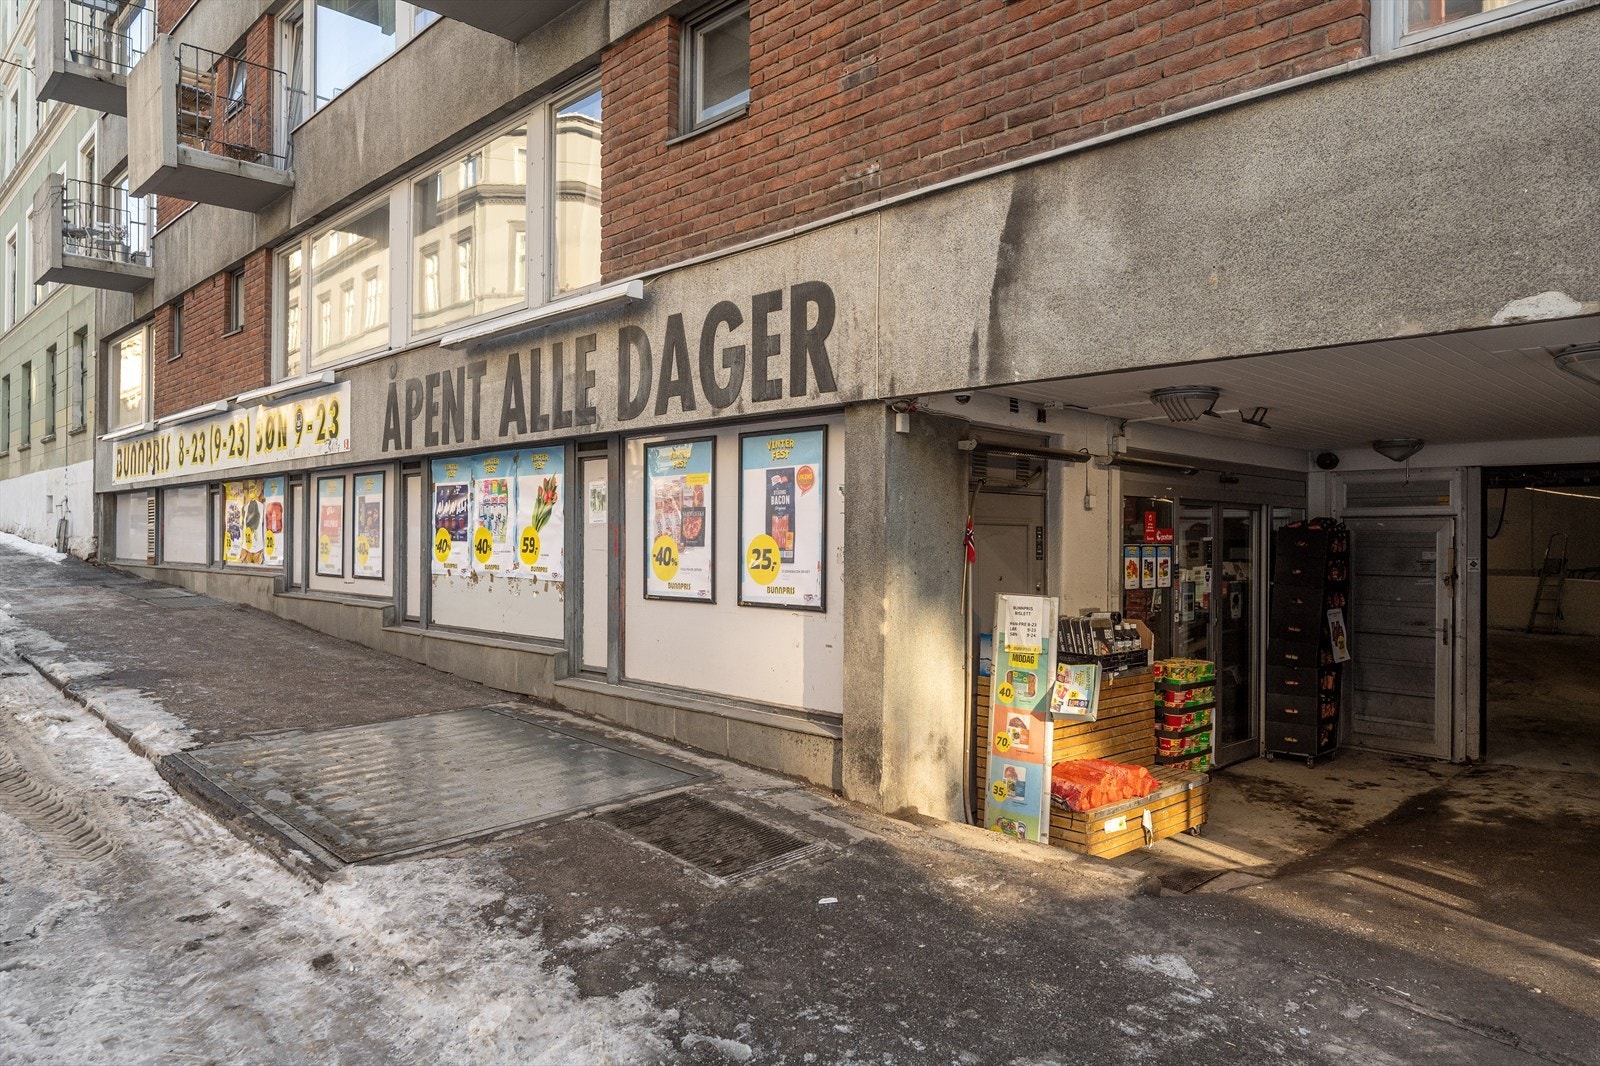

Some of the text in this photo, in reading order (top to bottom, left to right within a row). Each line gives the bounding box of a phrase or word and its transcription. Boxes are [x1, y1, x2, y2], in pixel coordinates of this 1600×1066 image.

[382, 280, 838, 452] ÅPENT ALLE DAGER
[116, 434, 171, 478] BUNNPRIS
[178, 430, 206, 467] 8-23
[295, 398, 339, 446] 9-23
[767, 438, 795, 450] VINTER
[771, 449, 791, 461] FEST
[770, 495, 791, 506] BACON
[653, 546, 678, 567] -40%
[668, 582, 691, 590] BUNNPRIS
[766, 586, 795, 594] BUNNPRIS
[1012, 653, 1035, 664] MIDDAG
